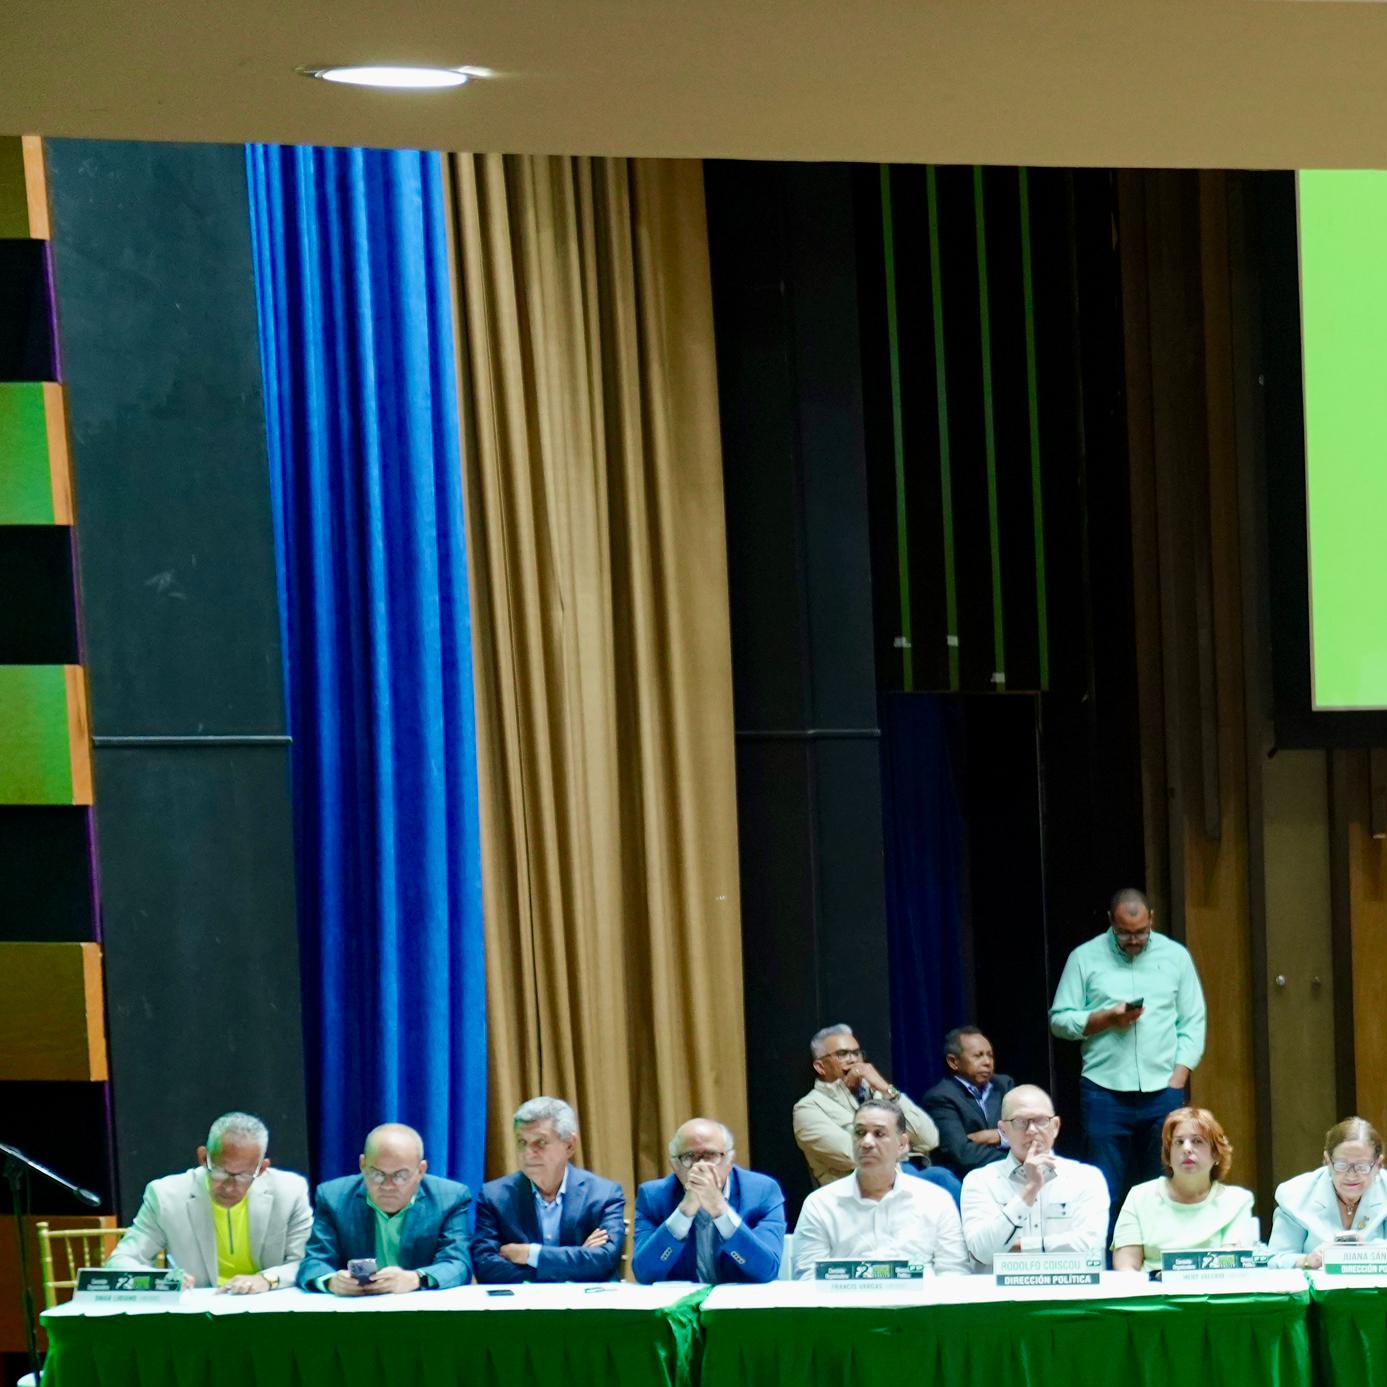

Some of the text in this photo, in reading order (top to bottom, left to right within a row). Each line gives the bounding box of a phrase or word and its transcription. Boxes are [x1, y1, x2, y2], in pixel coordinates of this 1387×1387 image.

[1001, 1260, 1041, 1270] RODOLFO
[1004, 1273, 1091, 1285] DIRECCIÓN POLÍTICA
